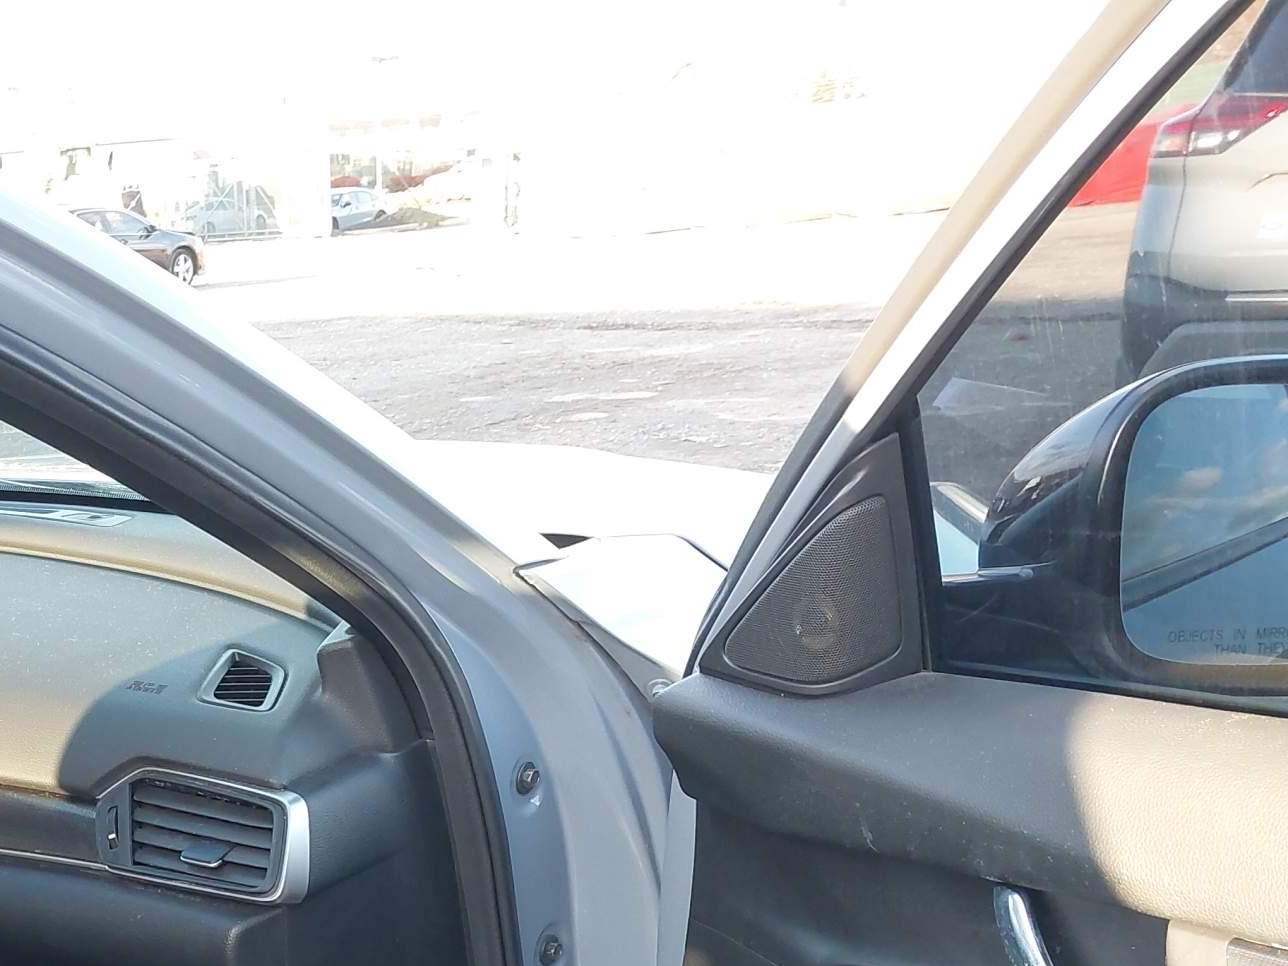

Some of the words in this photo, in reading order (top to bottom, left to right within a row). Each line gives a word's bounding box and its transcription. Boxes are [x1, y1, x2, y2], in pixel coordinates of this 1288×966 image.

[1167, 629, 1224, 644] OBJECTS
[1232, 627, 1247, 641] IN
[1214, 642, 1247, 655] THAN
